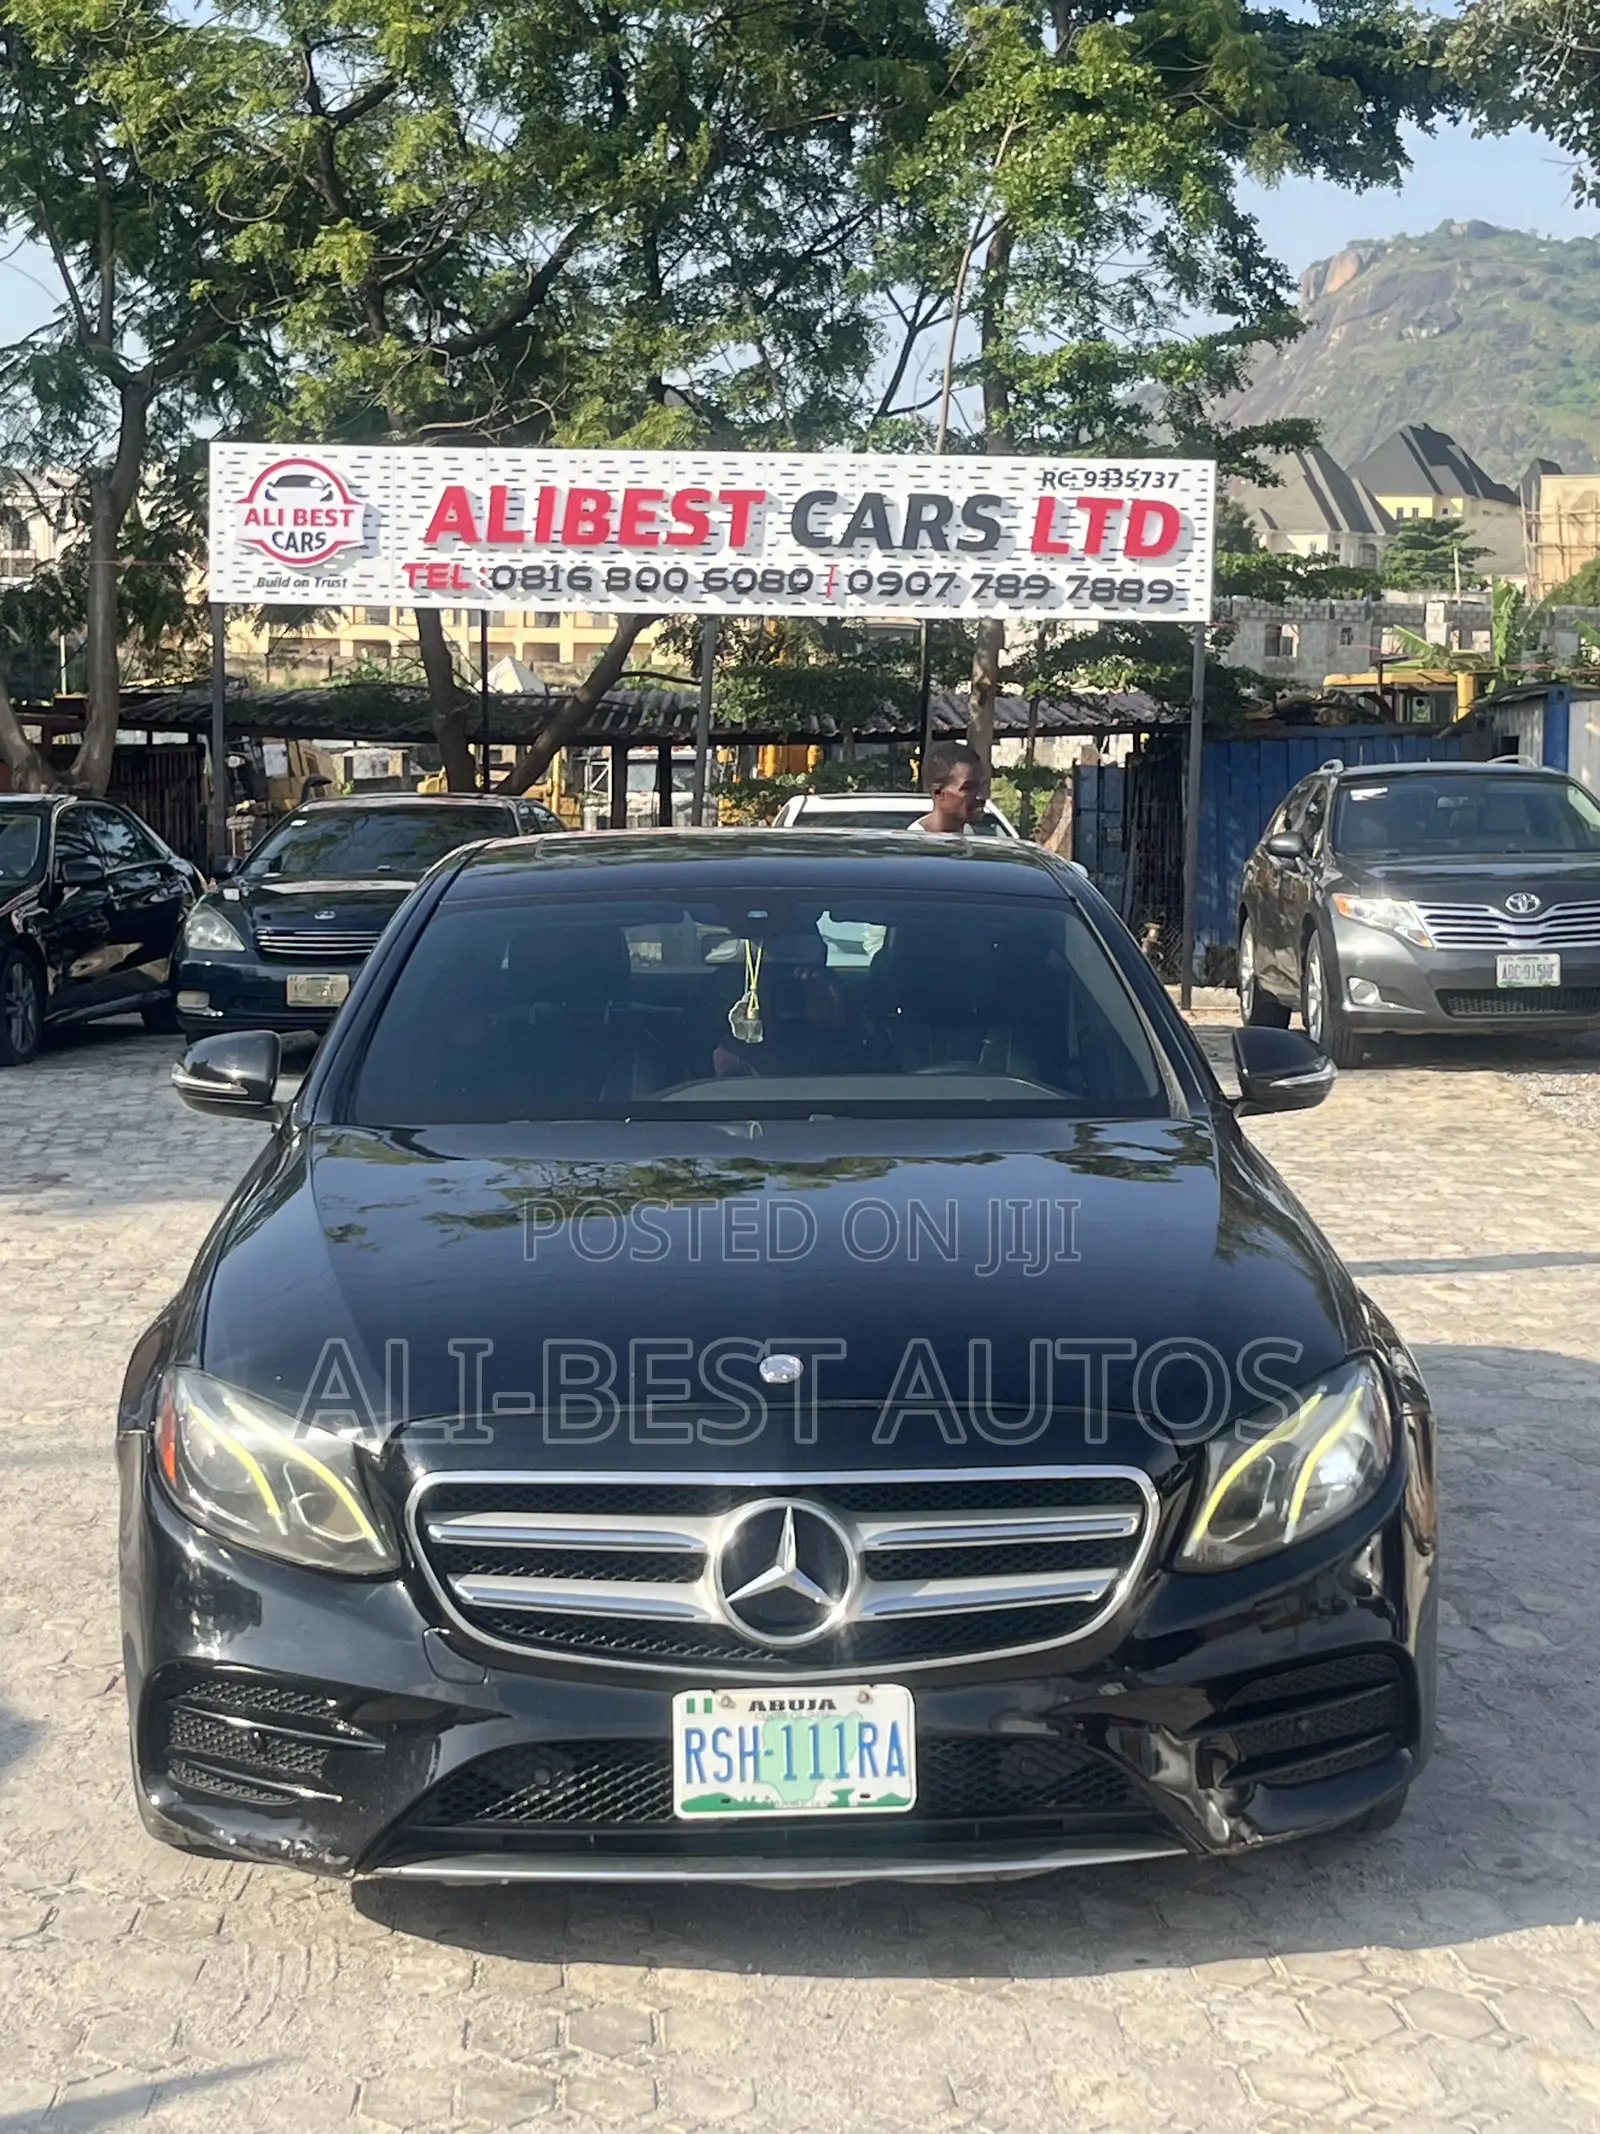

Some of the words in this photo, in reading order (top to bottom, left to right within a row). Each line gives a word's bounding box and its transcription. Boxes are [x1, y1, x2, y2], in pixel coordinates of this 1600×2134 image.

[244, 507, 284, 527] ALI
[293, 508, 355, 527] BEST
[422, 485, 767, 547] ALIBEST
[790, 489, 1003, 553] CARS
[1030, 496, 1181, 558] LTD
[272, 531, 327, 553] CARS
[256, 576, 291, 588] Build
[293, 578, 310, 588] on
[315, 576, 348, 589] Trust
[604, 566, 689, 594] 800
[703, 567, 814, 595] 6080
[847, 569, 956, 598] 0907
[970, 573, 1051, 601] 789
[1065, 574, 1174, 604] 7889
[748, 1698, 837, 1712] ABUJA
[684, 1720, 907, 1784] RSH-111RA
